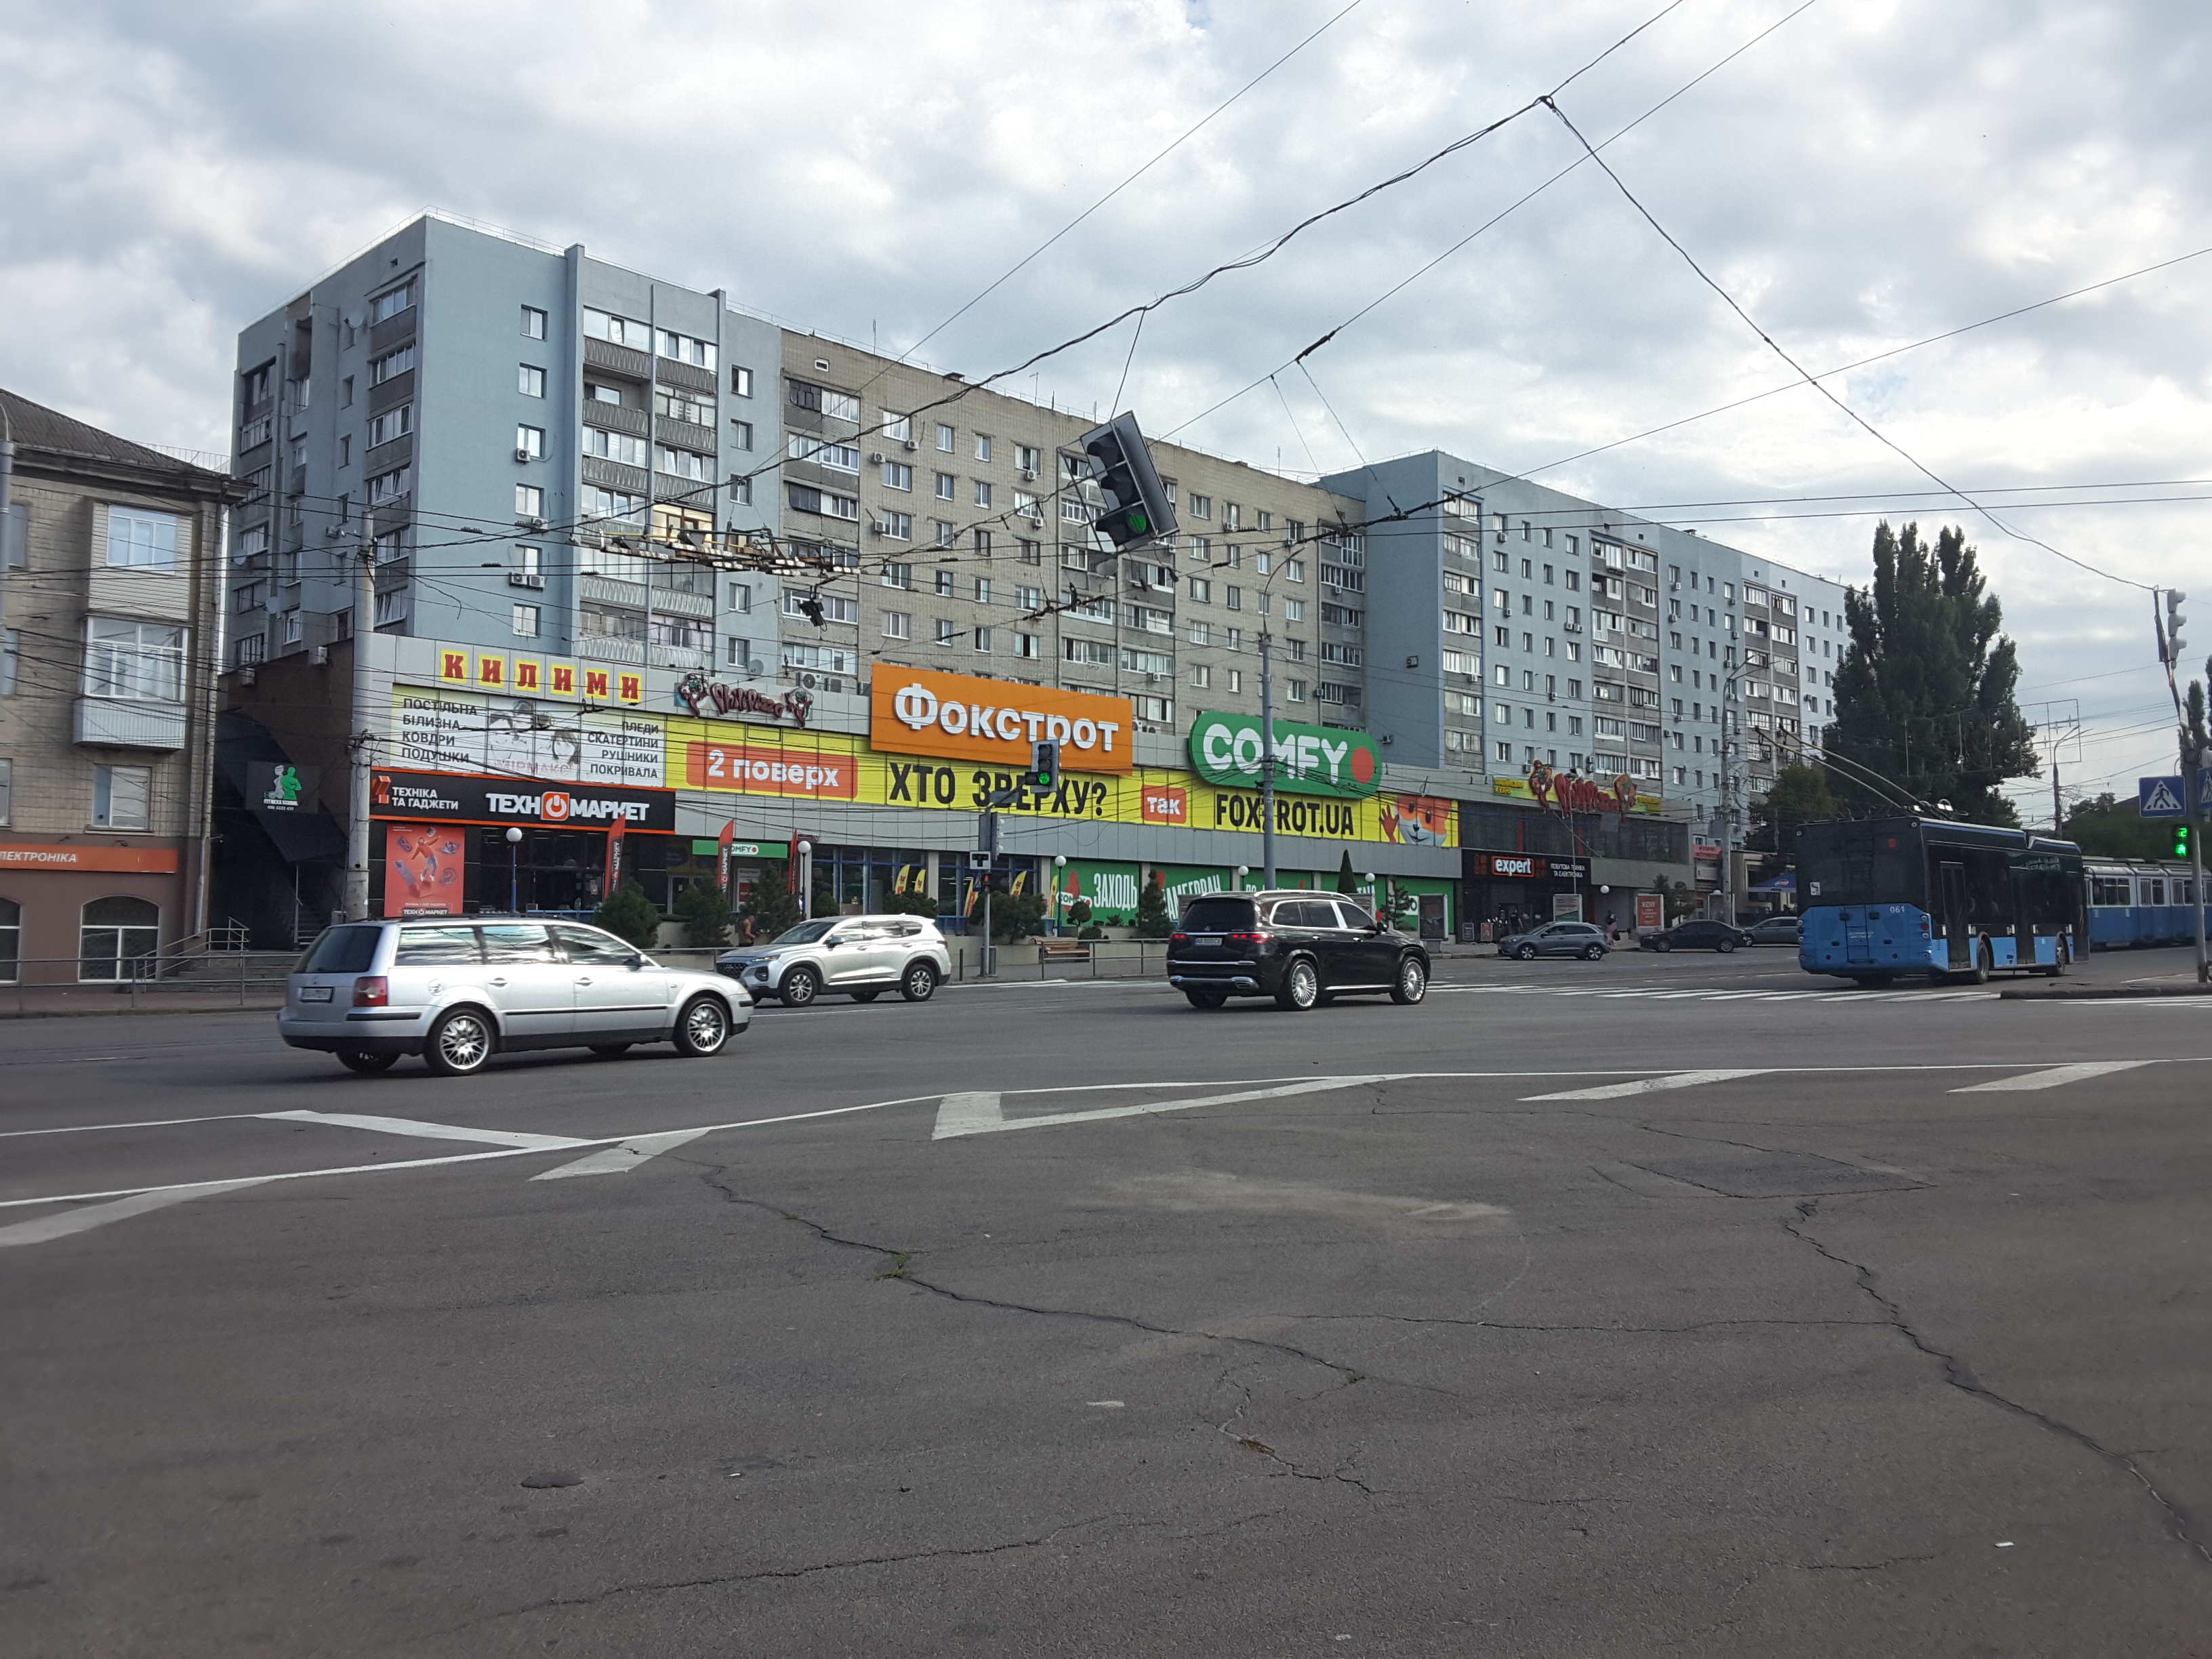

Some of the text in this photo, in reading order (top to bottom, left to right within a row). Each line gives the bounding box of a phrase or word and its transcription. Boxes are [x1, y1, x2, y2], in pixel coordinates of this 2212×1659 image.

[445, 654, 639, 699] КИЛИМИ
[403, 699, 477, 716] ПОСТІЛЬНА
[403, 714, 460, 730] БІЛИЗНА
[893, 683, 1118, 752] Фокстрот
[621, 722, 659, 734] ПЛЕДИ
[402, 731, 455, 747] КОВДРИ
[588, 733, 659, 748] СКАТЕРТИНИ
[402, 747, 469, 763] ПОДУШКИ
[601, 750, 658, 763] РУШНИКИ
[1203, 723, 1347, 784] COMFY
[590, 764, 658, 779] ПОКРИВАЛА
[708, 750, 839, 790] 2 поверх
[889, 762, 956, 804] ХТО
[392, 786, 438, 798] ТЕХНІКА
[392, 797, 459, 811] ТА ГАДЖЕТИ
[1147, 796, 1181, 815] так
[1216, 794, 1354, 836] FOXROT.UA
[1496, 858, 1532, 876] expert
[1094, 872, 1137, 911] ЗАХОДЬ
